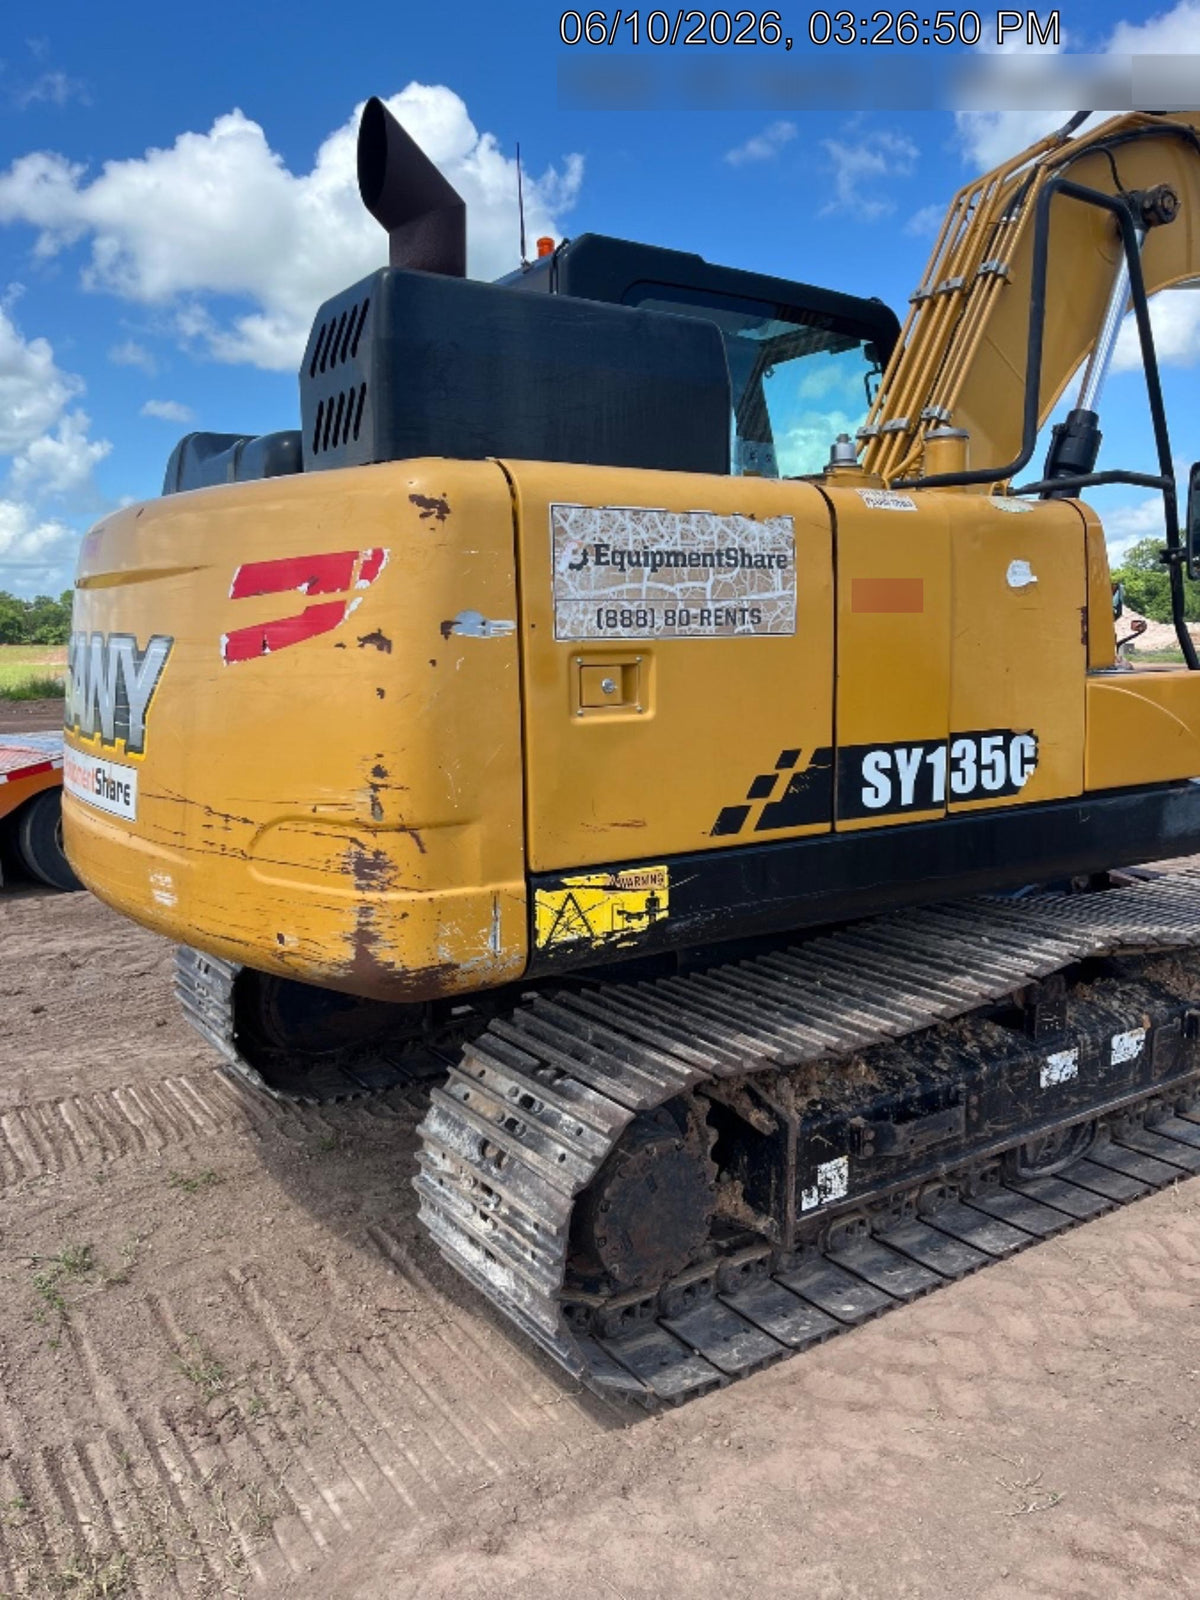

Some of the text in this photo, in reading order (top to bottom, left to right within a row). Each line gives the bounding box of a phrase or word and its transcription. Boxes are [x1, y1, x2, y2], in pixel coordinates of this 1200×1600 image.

[594, 544, 788, 573] EquipmentShare
[597, 607, 762, 629] (888) 80-RENTS
